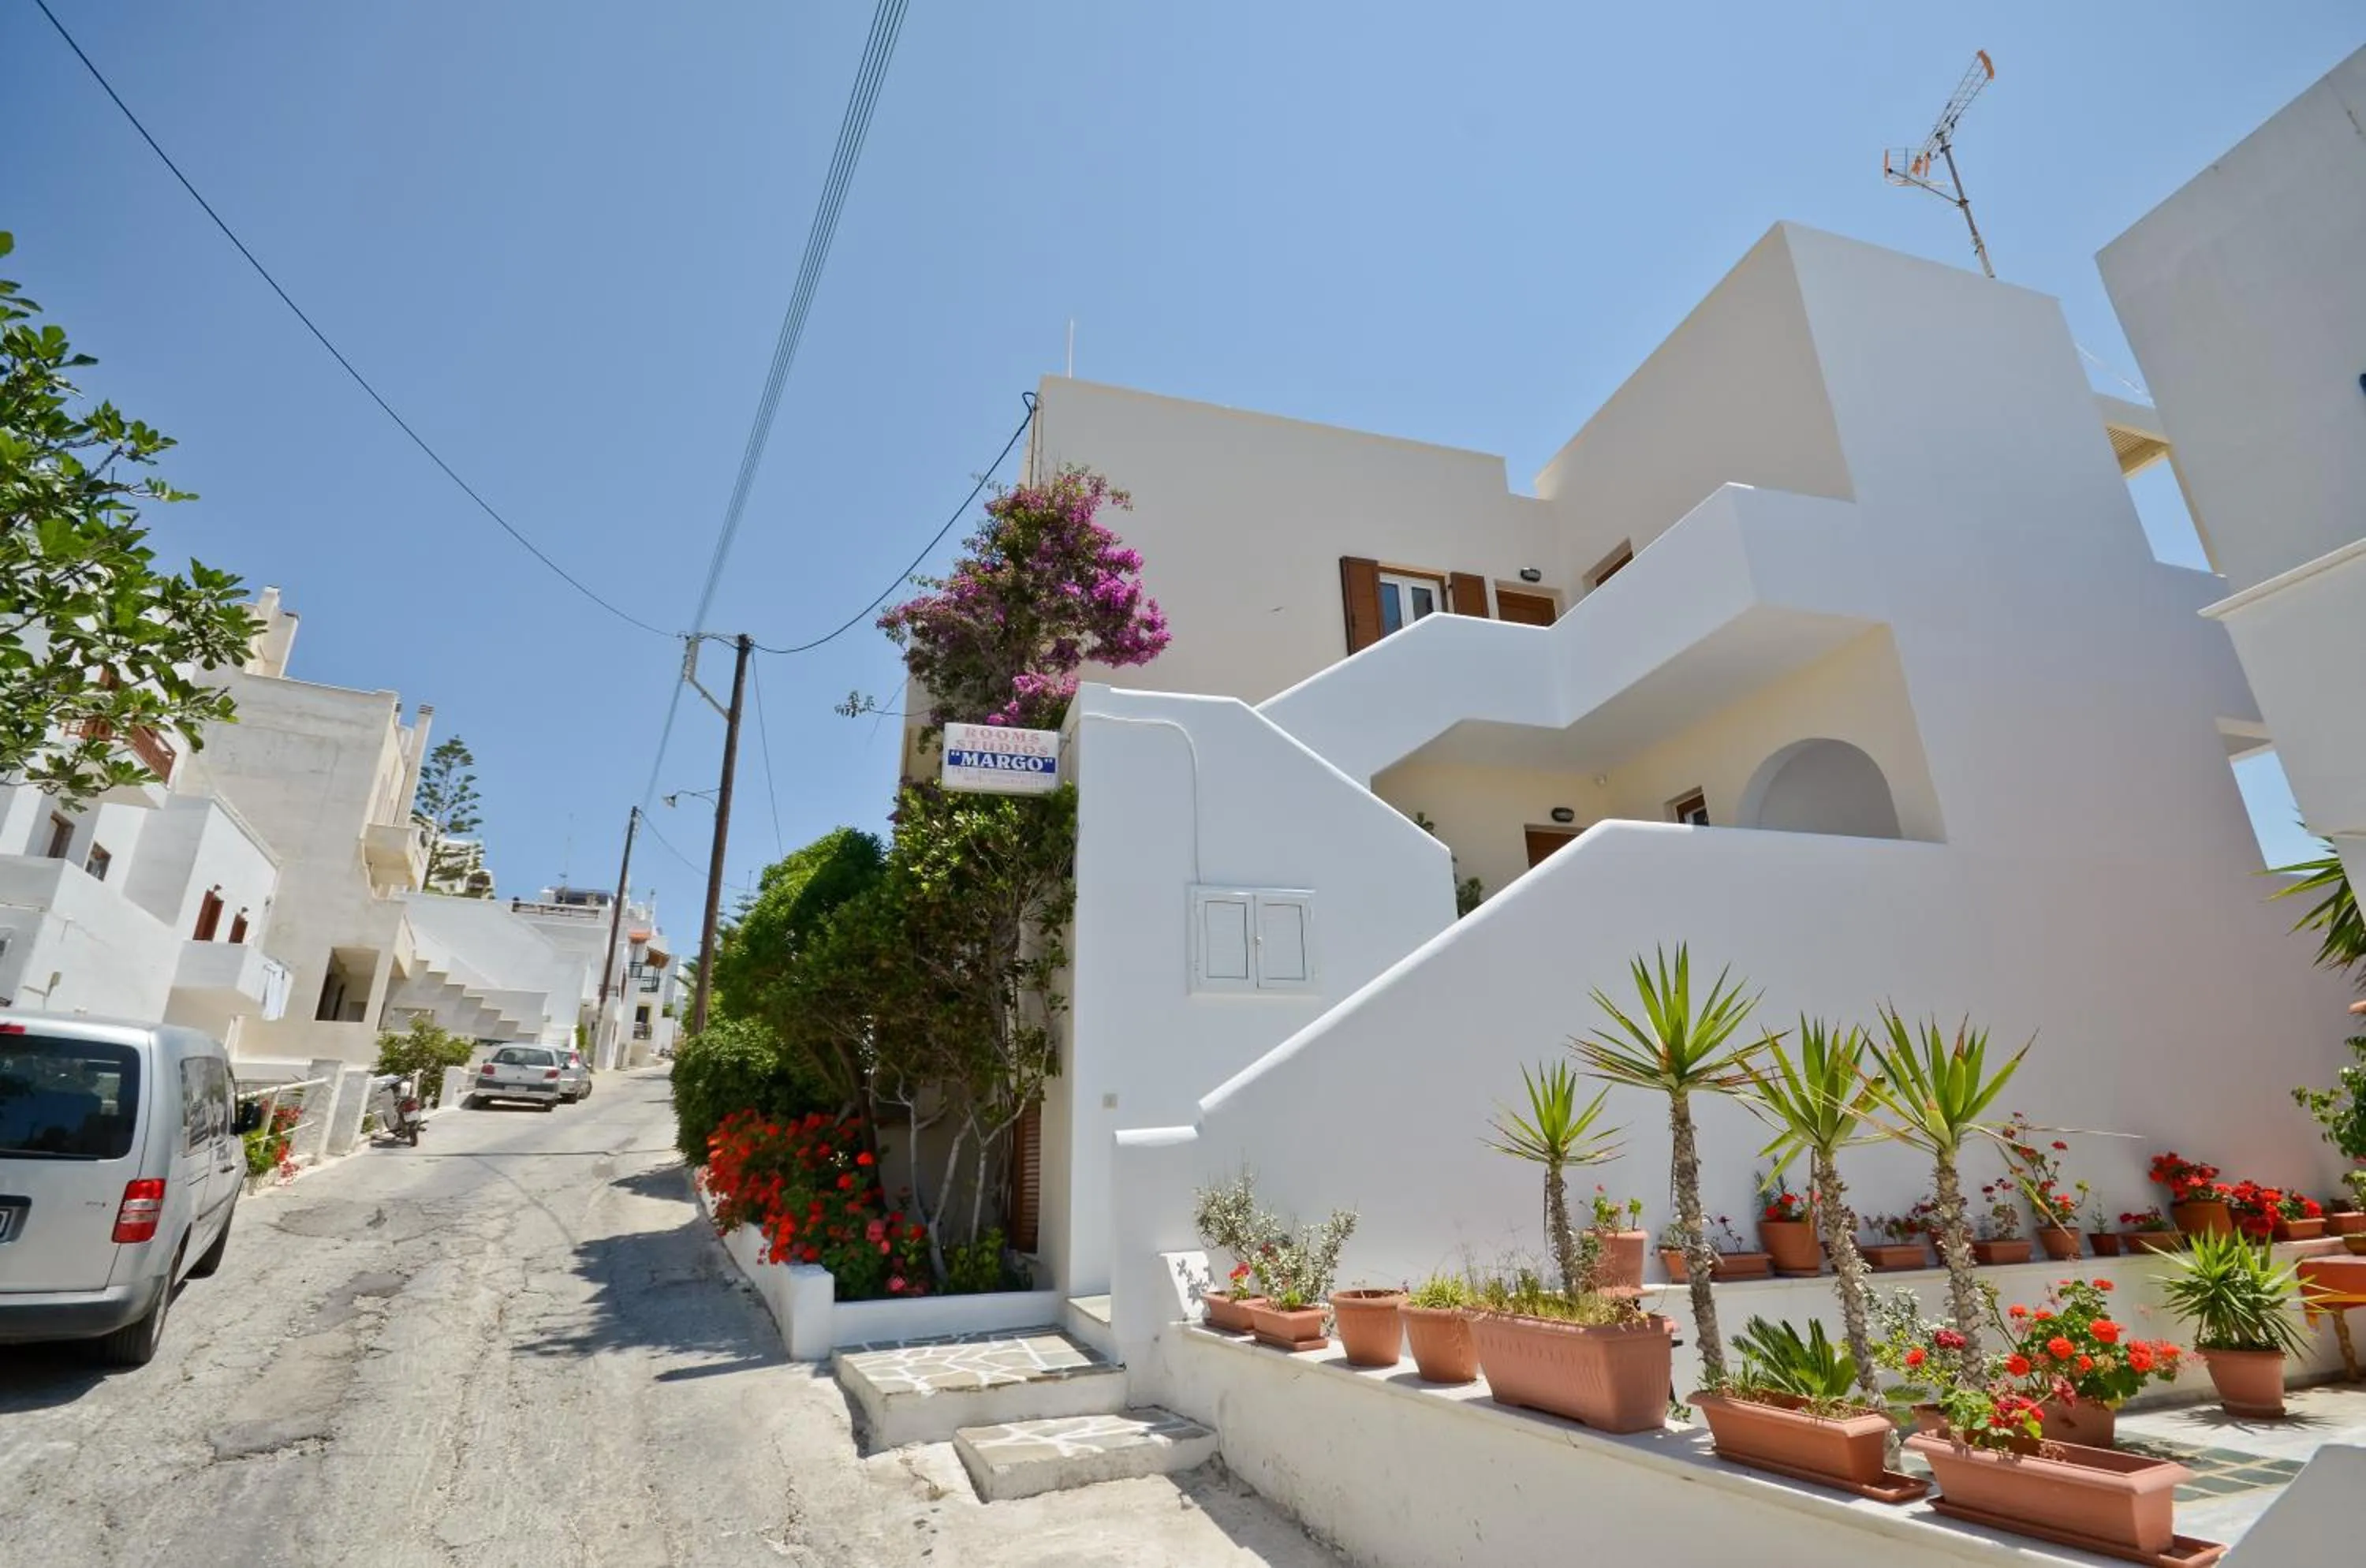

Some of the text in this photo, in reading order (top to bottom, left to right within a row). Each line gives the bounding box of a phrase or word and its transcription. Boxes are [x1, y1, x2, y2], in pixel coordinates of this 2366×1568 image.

[965, 727, 1040, 742] ROOMS
[955, 739, 1049, 756] STUDIOS
[950, 750, 1054, 771] "MARGO"
